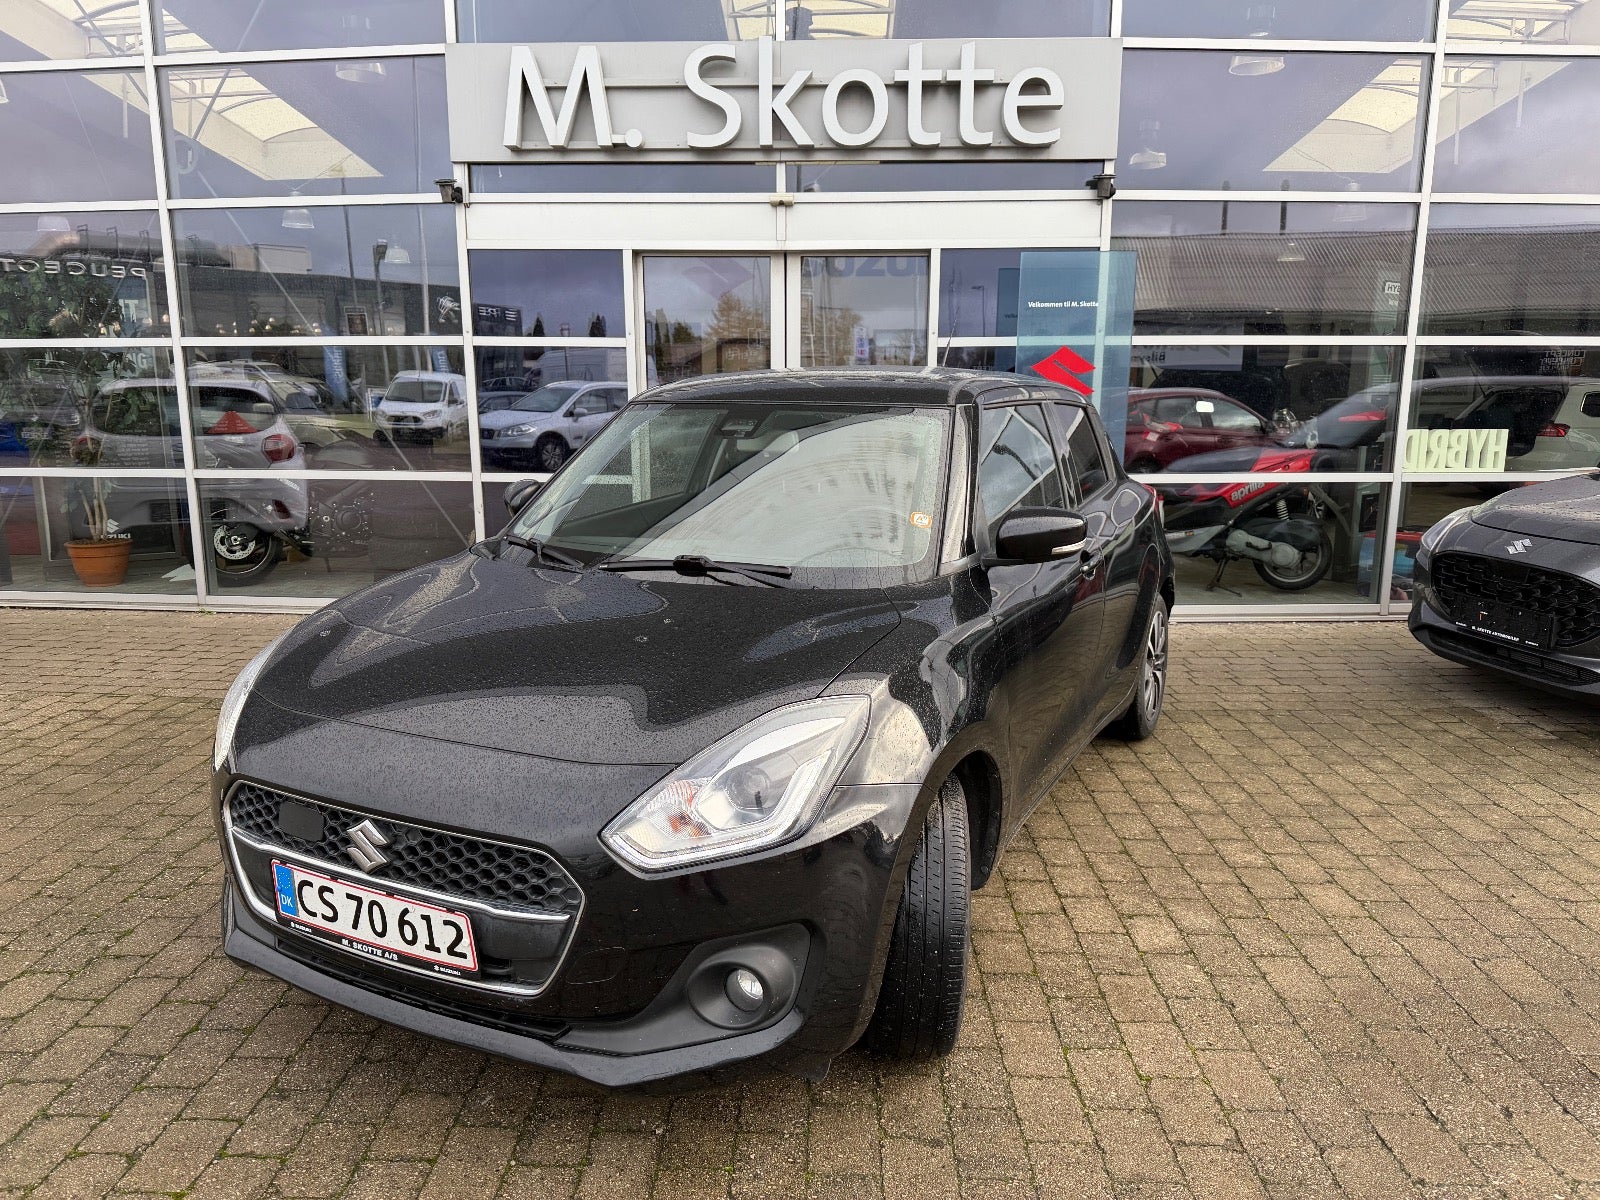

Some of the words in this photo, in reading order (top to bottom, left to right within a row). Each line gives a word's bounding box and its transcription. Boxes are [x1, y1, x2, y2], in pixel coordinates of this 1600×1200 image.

[502, 44, 646, 150] M.
[683, 36, 1065, 150] Skotte
[281, 893, 294, 908] DK
[297, 879, 339, 923] CS
[345, 892, 388, 939] 70
[397, 907, 468, 960] 612
[341, 938, 351, 947] M.
[352, 941, 382, 957] SKOTTE
[384, 951, 398, 961] A/S
